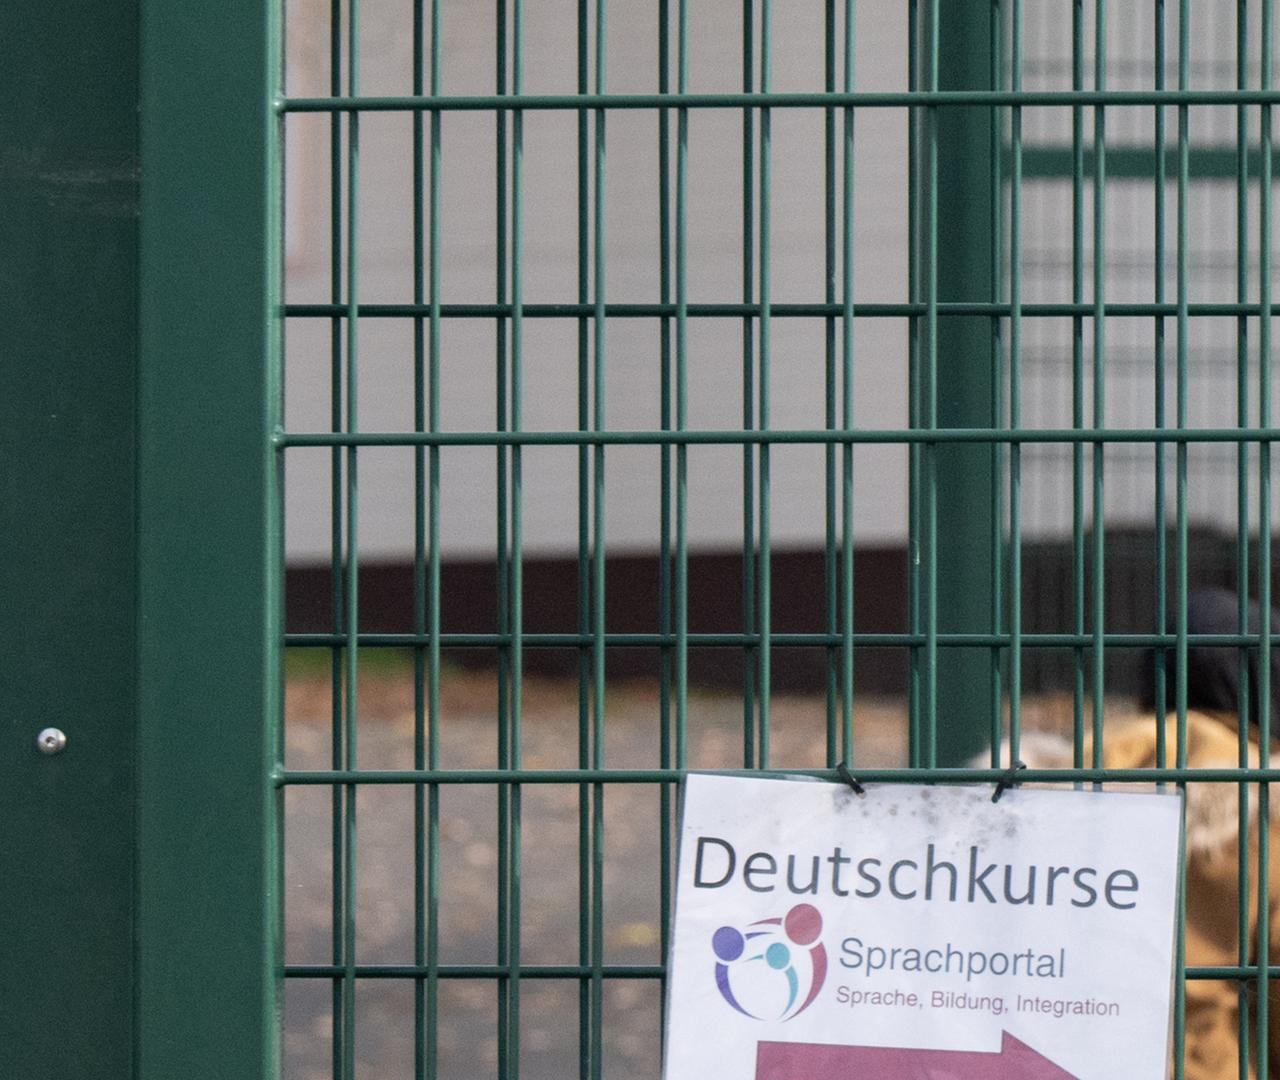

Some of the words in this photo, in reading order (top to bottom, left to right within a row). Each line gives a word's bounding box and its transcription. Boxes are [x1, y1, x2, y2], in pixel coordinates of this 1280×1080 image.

[692, 835, 1141, 911] Deutschkurse
[838, 936, 1066, 982] Sprachportal
[835, 984, 924, 1009] Sprache,
[930, 989, 1010, 1016] Bildung,
[1016, 993, 1121, 1019] Integration
